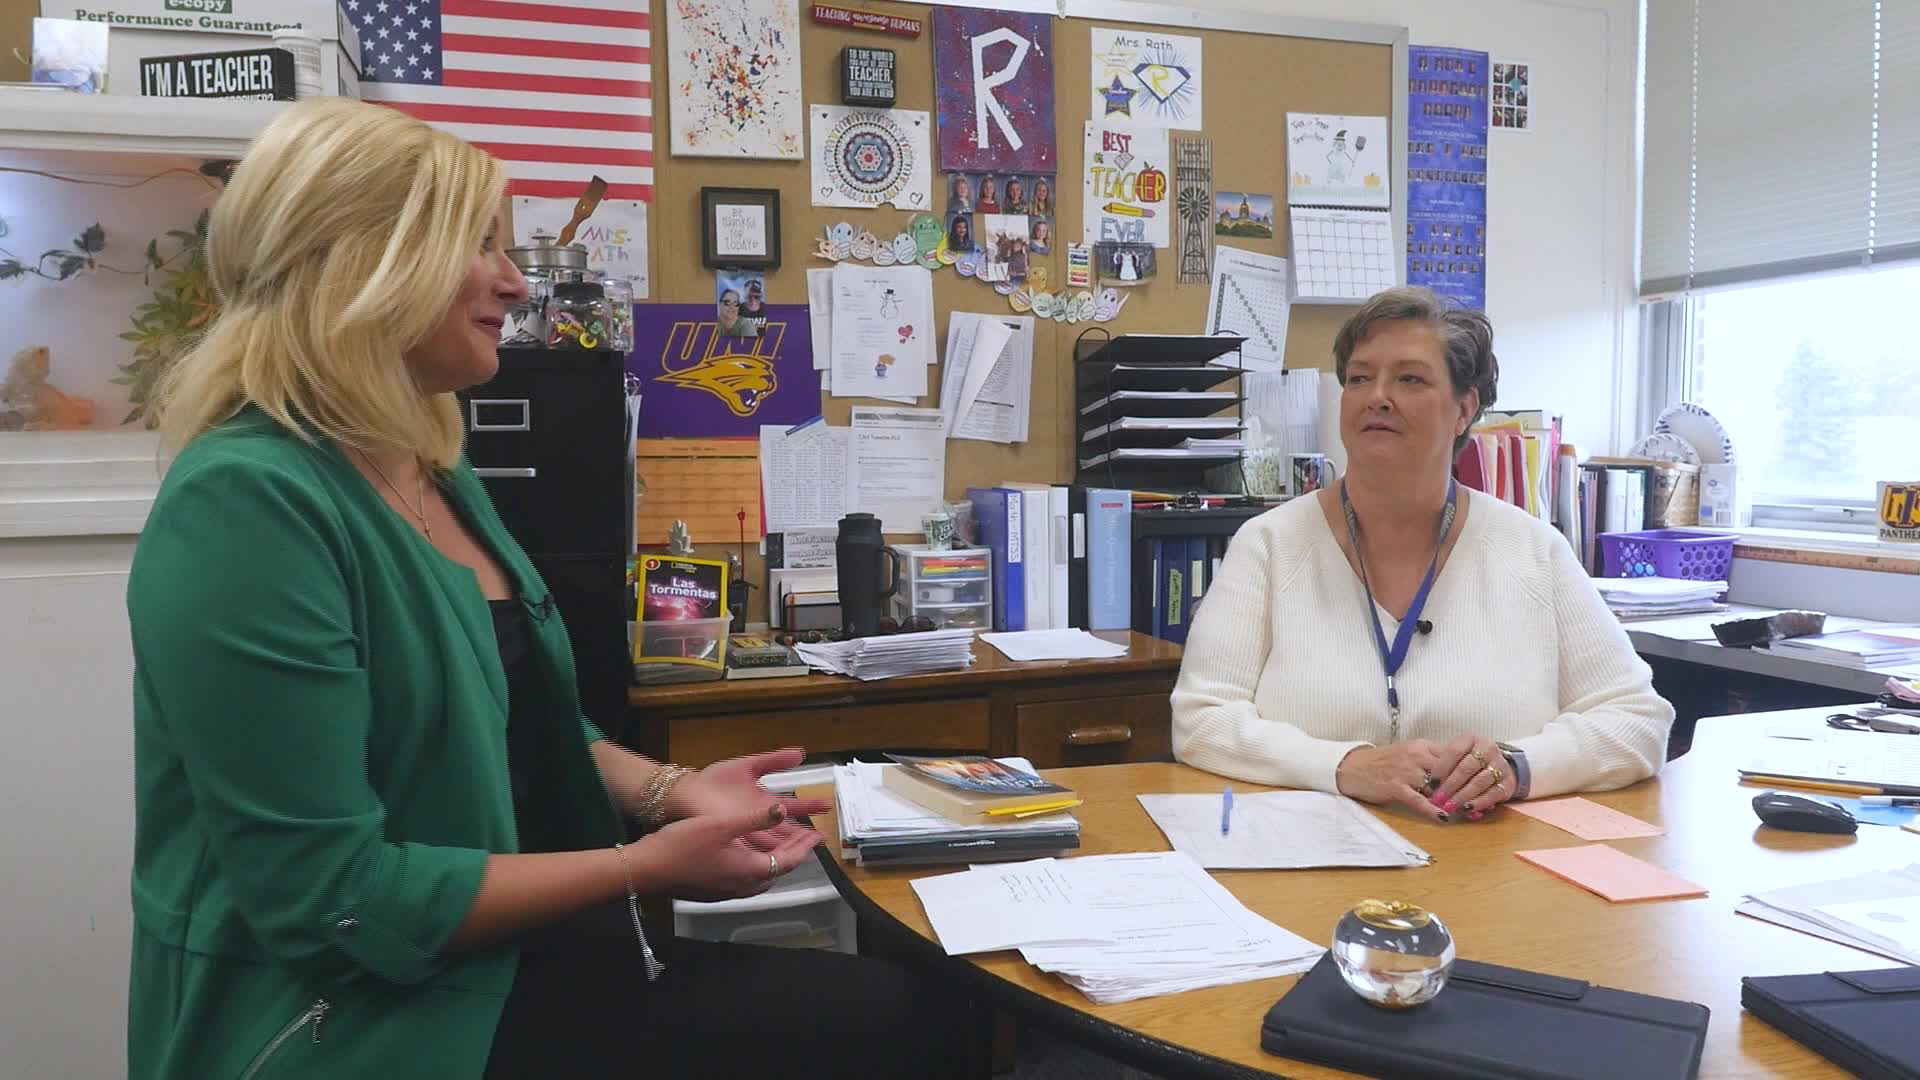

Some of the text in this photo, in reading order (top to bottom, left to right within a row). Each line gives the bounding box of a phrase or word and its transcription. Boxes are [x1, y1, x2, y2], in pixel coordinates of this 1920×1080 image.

[75, 9, 193, 27] Performance
[815, 7, 850, 21] TEACHING
[890, 18, 920, 32] HUMANS
[859, 49, 870, 60] THE
[1146, 39, 1173, 50] Rath
[145, 54, 273, 96] I'M A TEACHER
[971, 27, 1031, 151] R
[1103, 130, 1132, 153] BEST
[1090, 167, 1165, 203] TEACHER
[1101, 217, 1145, 242] EVER
[661, 321, 787, 374] UNI
[650, 584, 717, 599] Tormentas
[672, 577, 696, 588] Las
